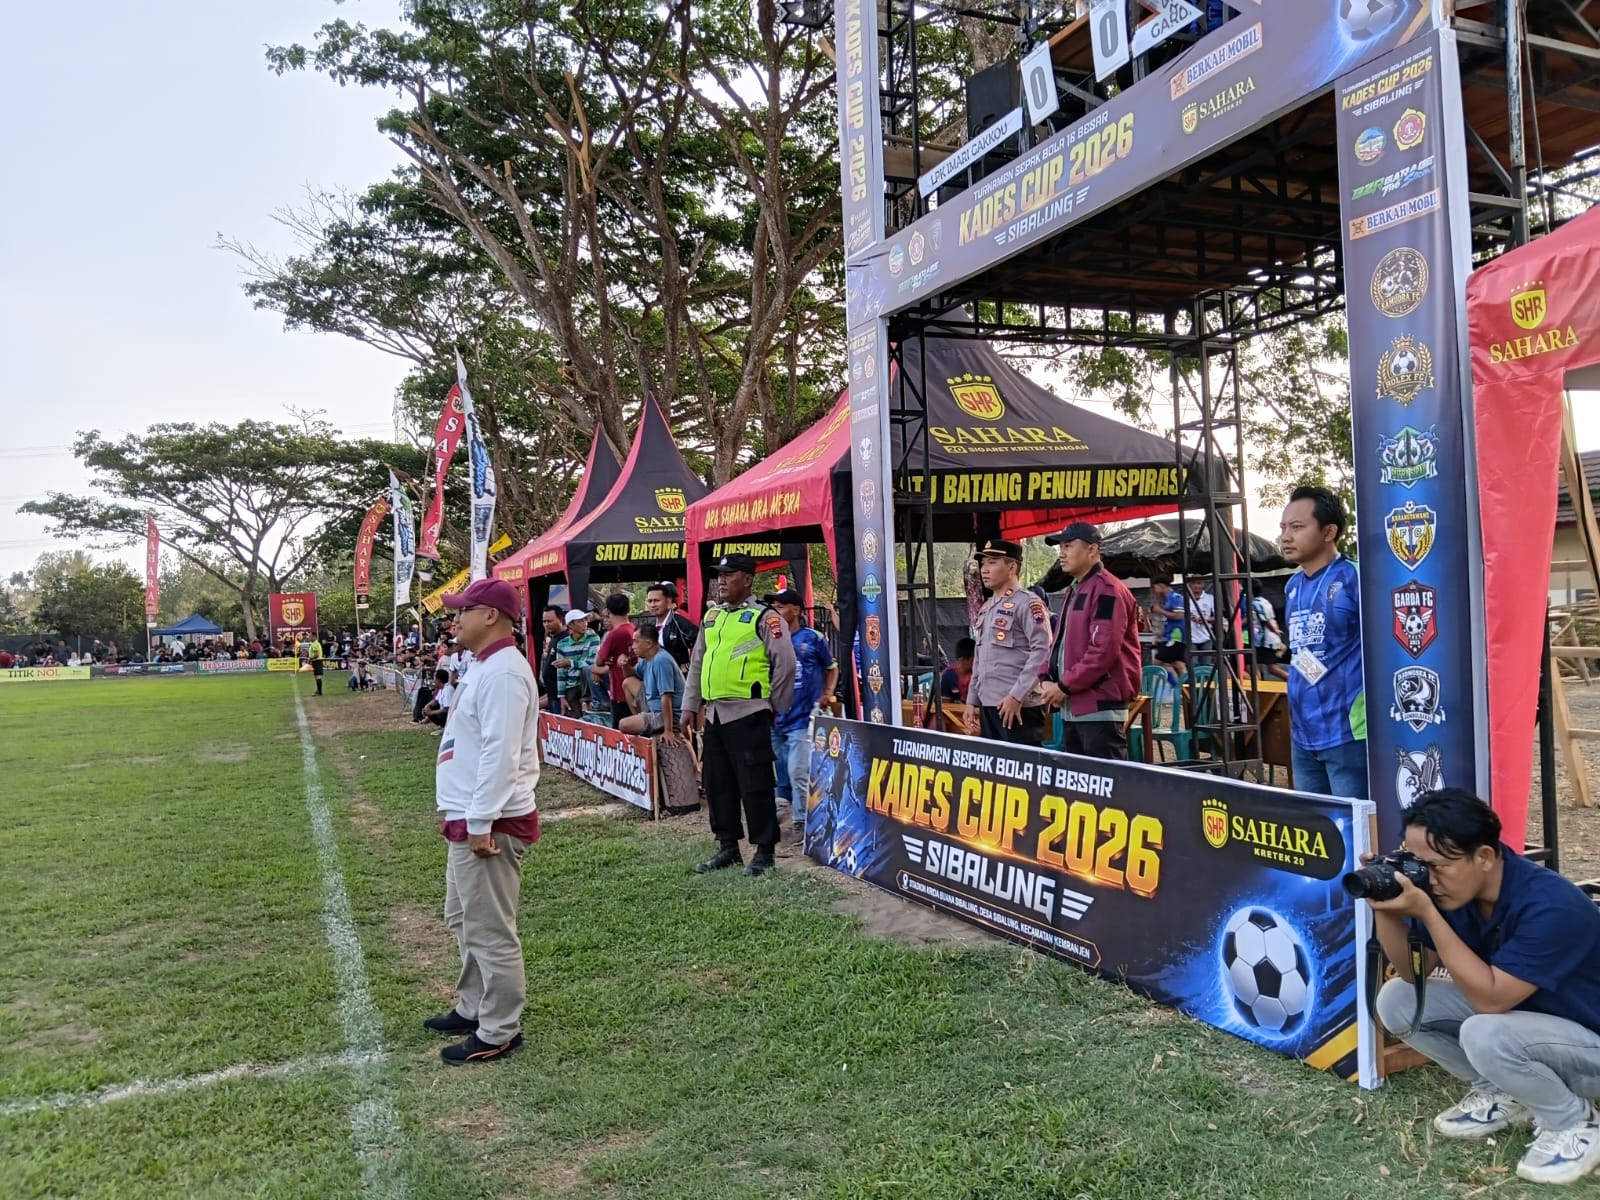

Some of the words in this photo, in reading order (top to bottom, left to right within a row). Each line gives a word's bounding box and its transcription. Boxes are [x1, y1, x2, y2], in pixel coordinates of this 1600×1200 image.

[1099, 9, 1119, 58] 0
[1186, 47, 1226, 84] BERKAH
[1227, 29, 1260, 59] MOBIL
[1030, 65, 1048, 110] 0
[1200, 76, 1256, 119] SAHARA
[1341, 83, 1376, 110] KADES
[1377, 72, 1400, 97] CUP
[1402, 55, 1433, 82] 2026
[1363, 83, 1413, 114] SIBALUNG
[846, 80, 865, 129] CUP
[848, 134, 868, 202] 2026
[930, 167, 947, 186] LPK
[946, 149, 970, 175] IMARI
[970, 122, 1008, 156] GAKKOU
[973, 170, 1014, 201] TURNAMEN
[1015, 152, 1041, 176] SEPAK
[1042, 139, 1065, 160] BOLA
[1077, 110, 1109, 139] BESAR
[959, 181, 1017, 247] KADES
[1020, 155, 1064, 213] CUP
[1069, 112, 1135, 186] 2026
[1007, 193, 1074, 243] SIBALUNG
[1366, 203, 1406, 229] BERKAH
[1515, 296, 1543, 321] SHR
[1489, 325, 1580, 364] SAHARA
[960, 391, 999, 414] SHR
[929, 426, 1081, 444] SAHARA
[947, 445, 967, 454] 20
[1046, 444, 1090, 452] TANGAN
[661, 498, 683, 509] SHR
[943, 472, 1023, 504] BATANG
[1027, 470, 1091, 500] PENUH
[705, 508, 719, 529] ORA
[721, 502, 749, 527] SAHARA
[751, 496, 768, 520] ORA
[148, 528, 157, 600] SAHARA
[359, 514, 378, 579] SAHARA
[596, 544, 628, 561] SATU
[631, 543, 680, 560] BATANG
[285, 607, 302, 621] SHR
[1394, 592, 1420, 607] GARDA
[1422, 591, 1433, 607] FC
[8, 669, 34, 678] TITIK
[37, 668, 60, 677] NOL
[597, 734, 648, 797] Sportivitas
[892, 738, 951, 765] TURNAMEN
[952, 749, 994, 773] SEPAK
[995, 757, 1034, 782] BOLA
[1036, 764, 1052, 787] 16
[1055, 768, 1114, 798] BESAR
[865, 757, 952, 832] KADES
[956, 775, 1030, 852] CUP
[1036, 794, 1164, 897] 2026
[1206, 814, 1225, 840] SHR
[1231, 814, 1329, 859] SAHARA
[1254, 847, 1291, 863] KRETEK
[1293, 856, 1305, 866] 20
[924, 841, 1056, 923] SIBALUNG
[1054, 935, 1091, 959] KEMRANJEN
